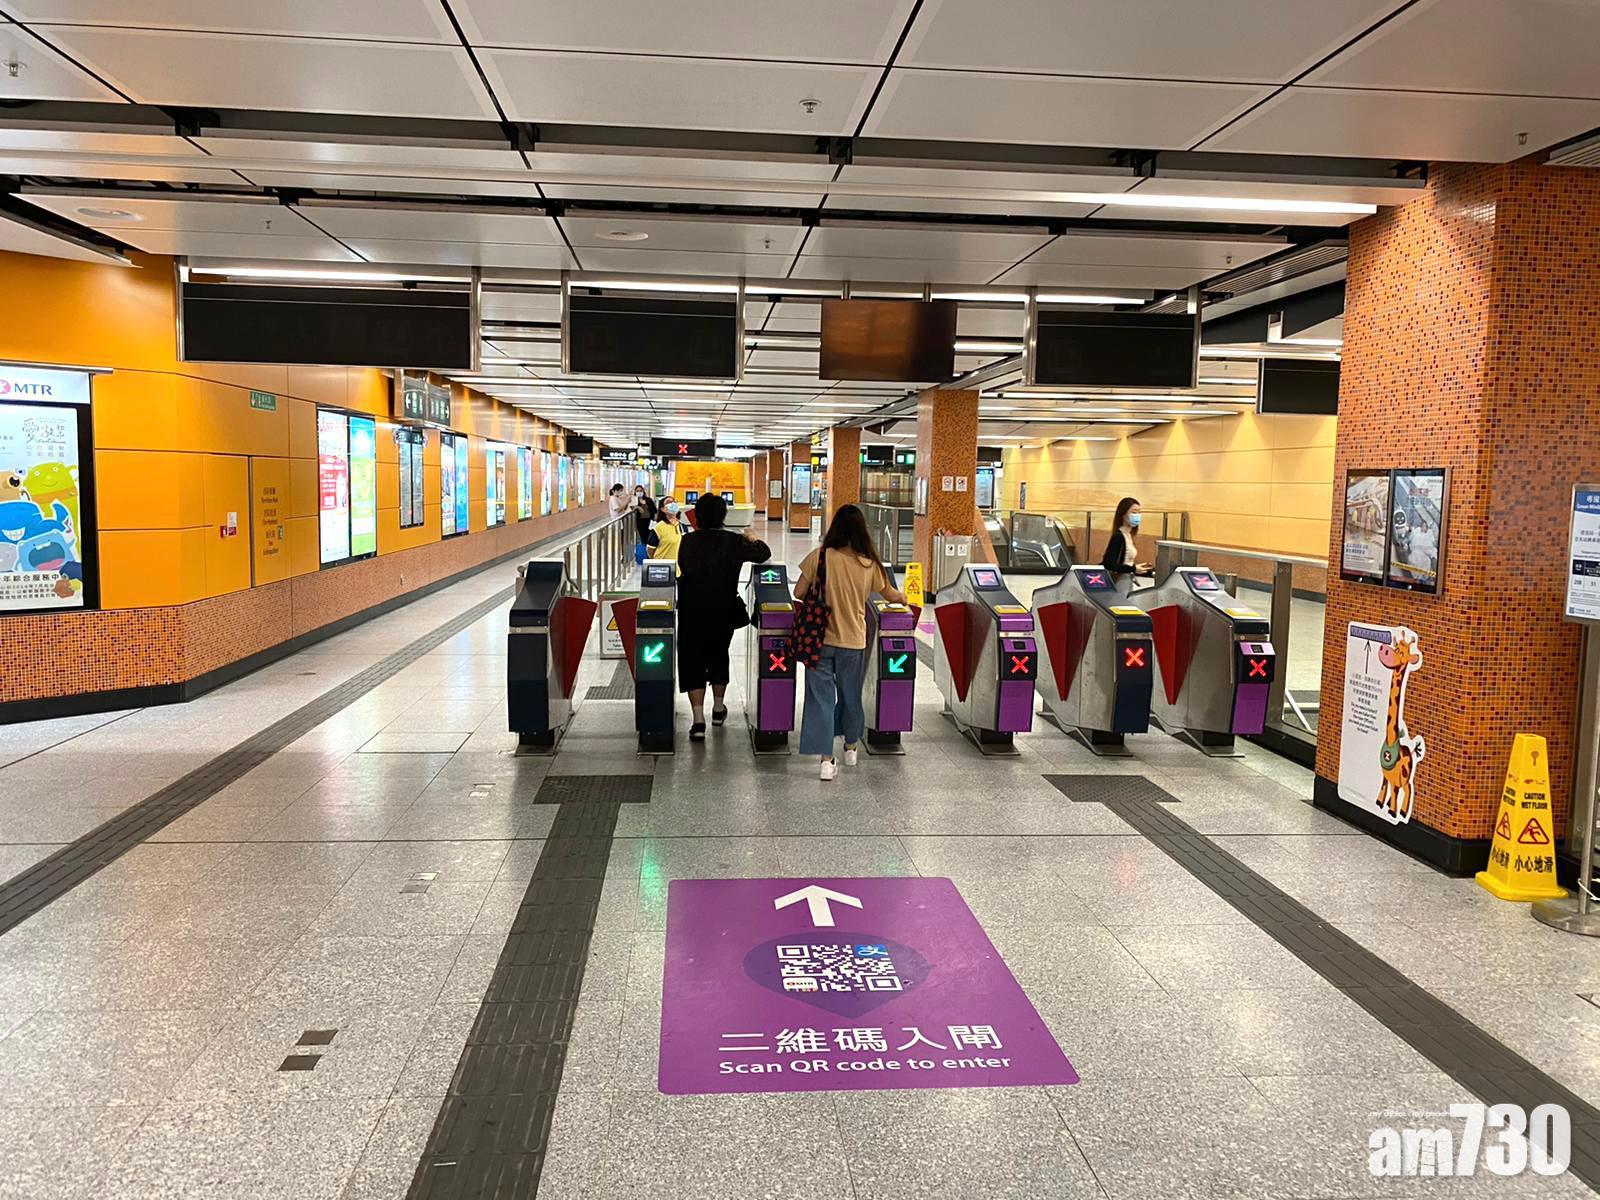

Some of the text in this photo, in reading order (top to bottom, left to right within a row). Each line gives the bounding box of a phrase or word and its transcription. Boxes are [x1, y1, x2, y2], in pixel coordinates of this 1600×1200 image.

[14, 383, 52, 395] MTR
[1524, 792, 1545, 800] CAUTION
[1514, 854, 1553, 873] 小心地滑
[718, 1024, 1003, 1054] 二維碼入閘
[719, 1056, 1011, 1074] Scan QR code to enter
